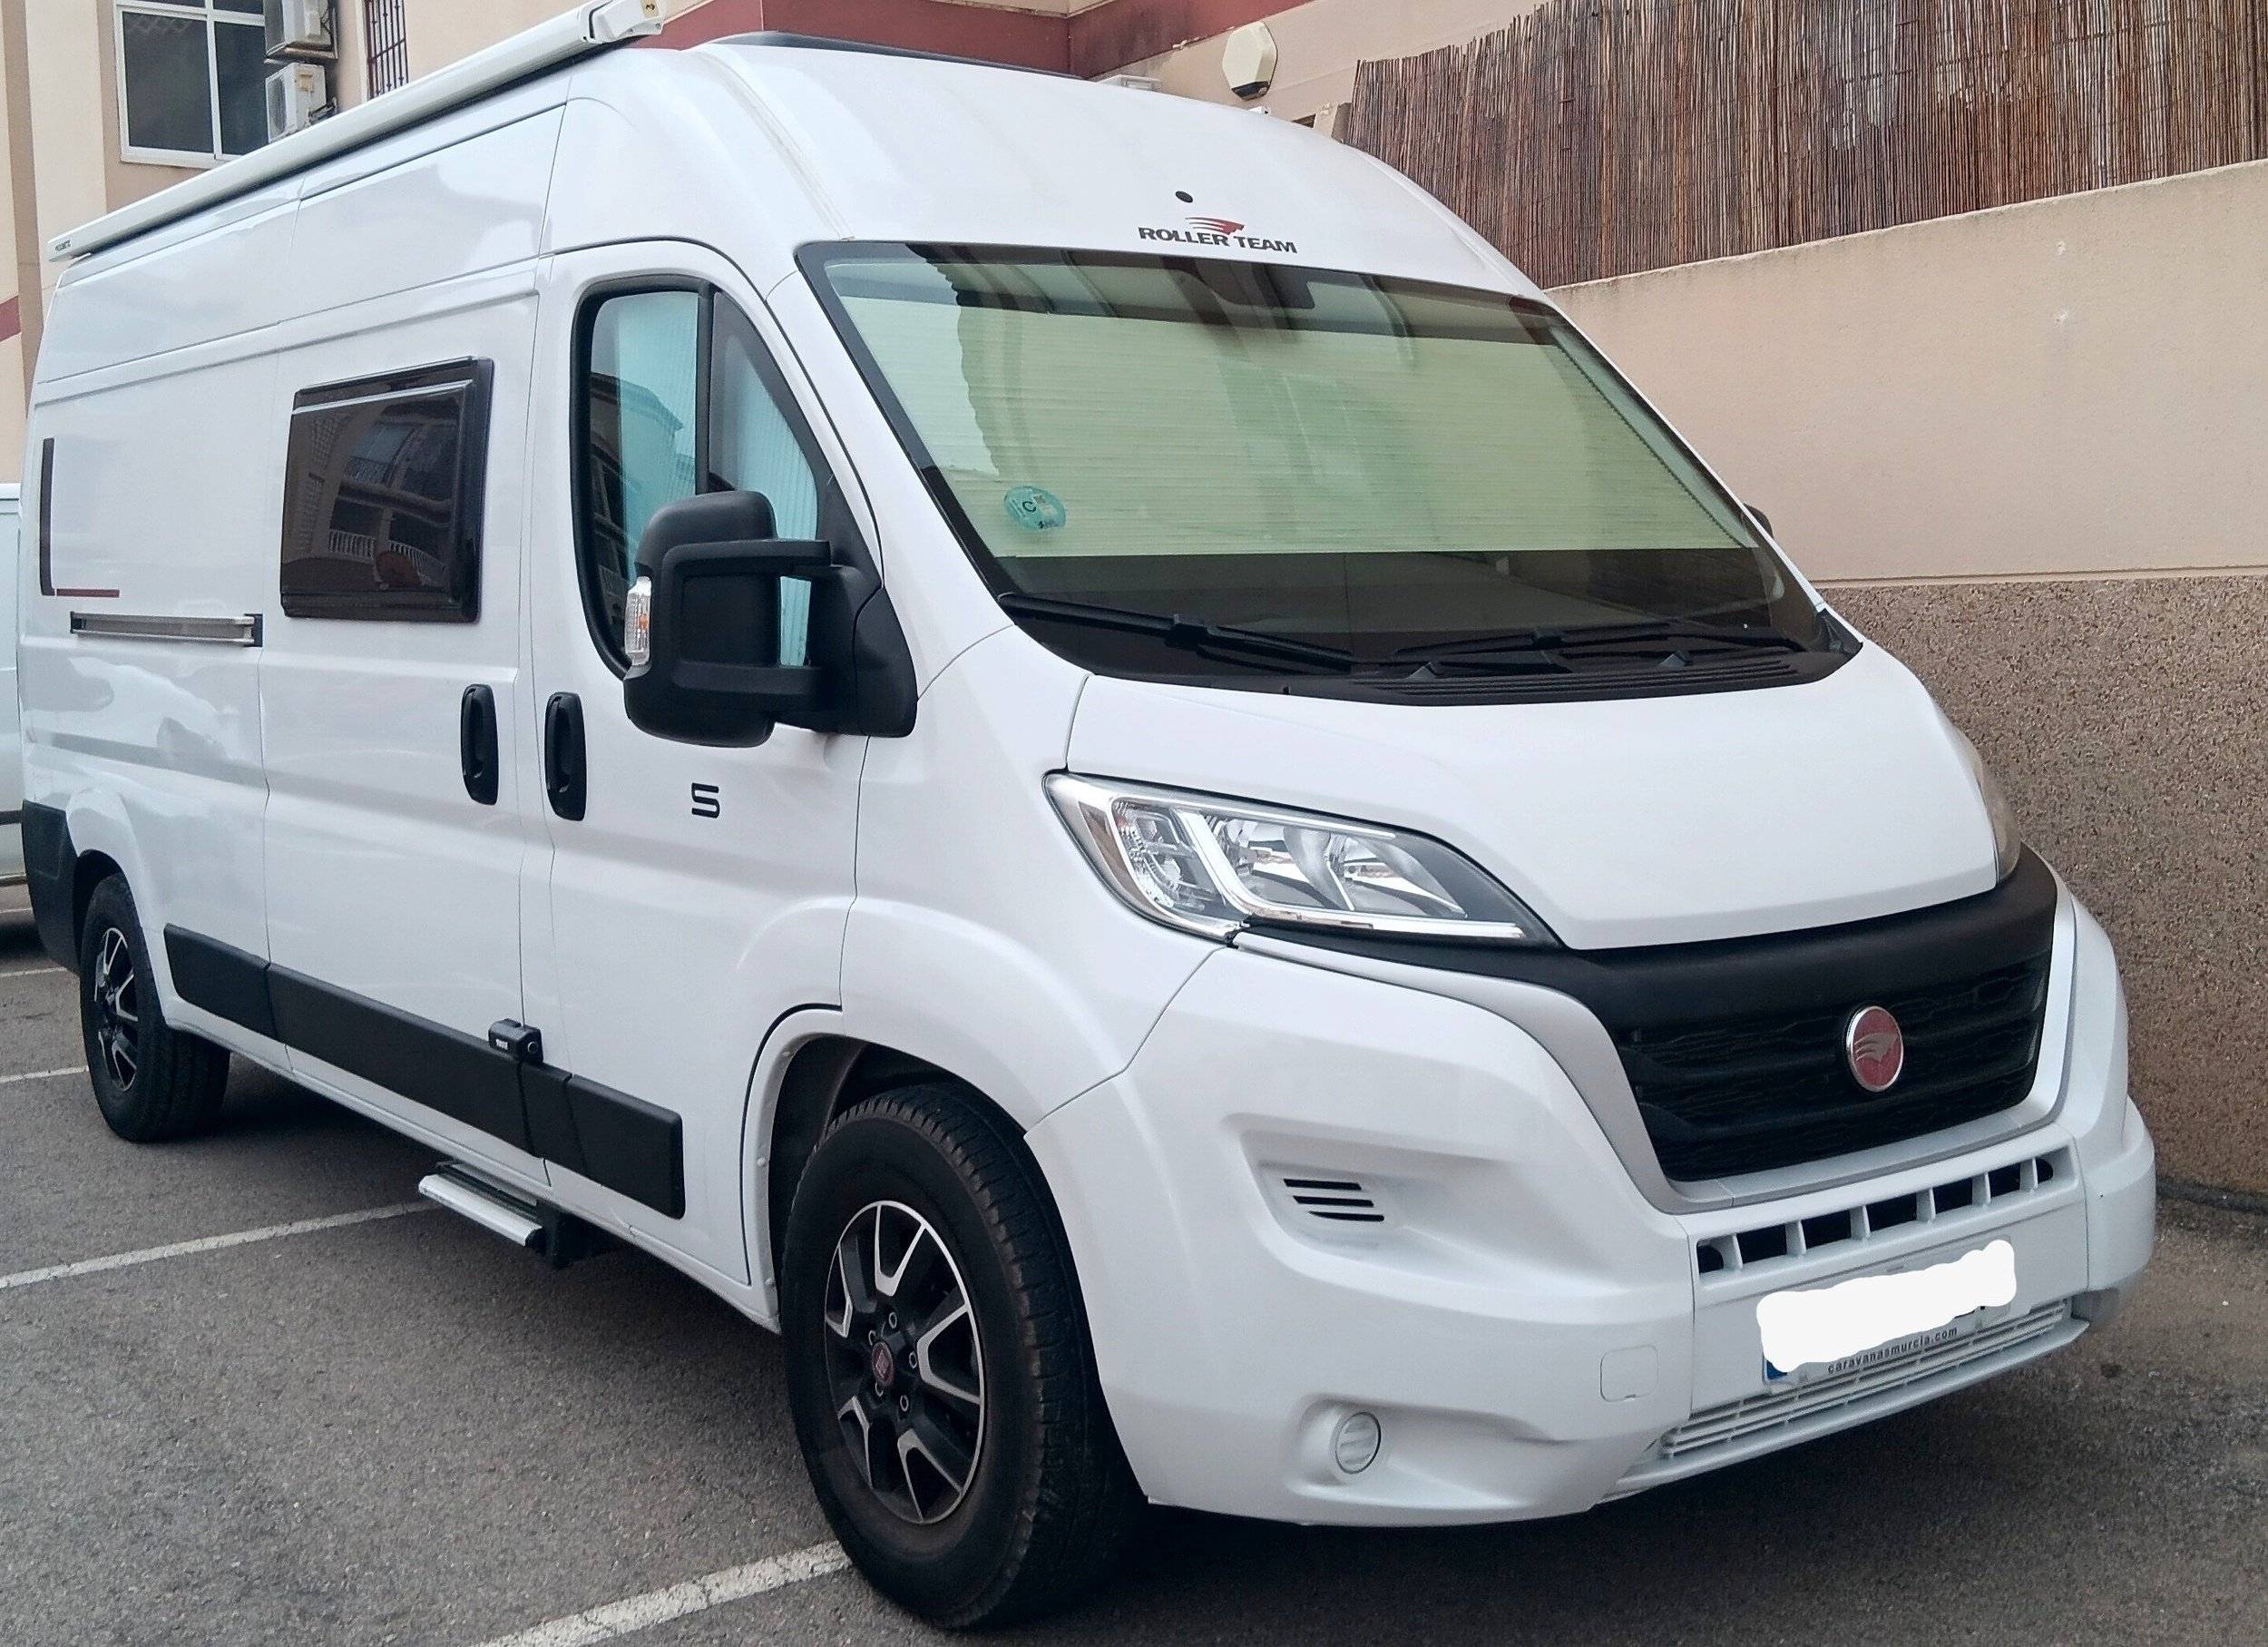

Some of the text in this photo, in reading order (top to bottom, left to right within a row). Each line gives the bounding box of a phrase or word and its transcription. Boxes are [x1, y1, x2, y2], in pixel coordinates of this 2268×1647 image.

[1138, 227, 1297, 253] ROLLER TEAM
[1827, 1327, 1958, 1373] caravanasmurcia.com
